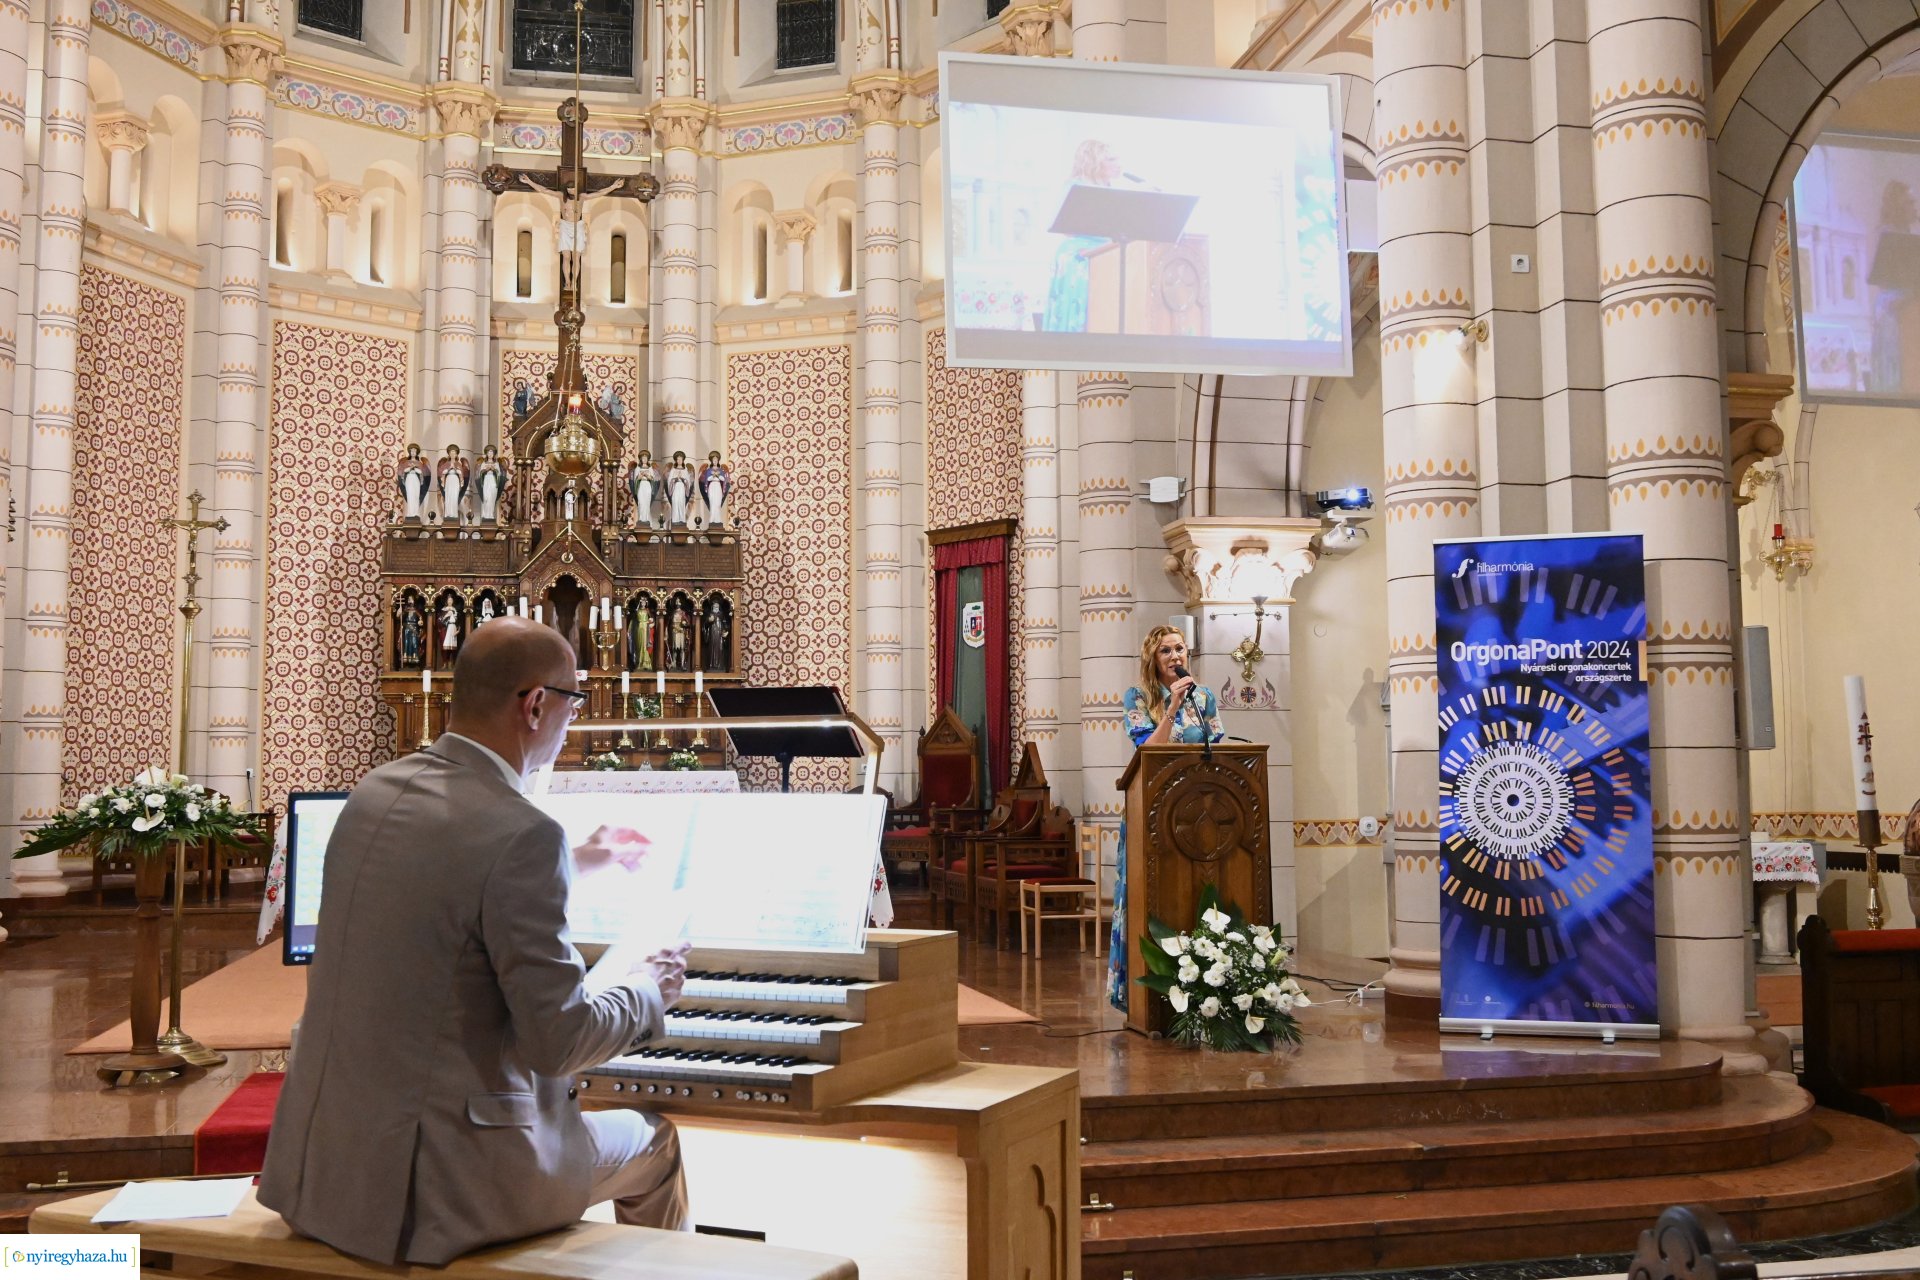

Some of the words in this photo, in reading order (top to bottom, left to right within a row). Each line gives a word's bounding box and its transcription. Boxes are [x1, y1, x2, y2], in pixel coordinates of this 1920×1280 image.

[1477, 562, 1534, 573] filharmónia
[1450, 638, 1583, 666] OrgonaPont
[1587, 641, 1632, 659] 2024
[1520, 663, 1557, 674] Nyáresti
[1558, 662, 1632, 672] orgonakoncertek
[1575, 673, 1632, 683] országszerte
